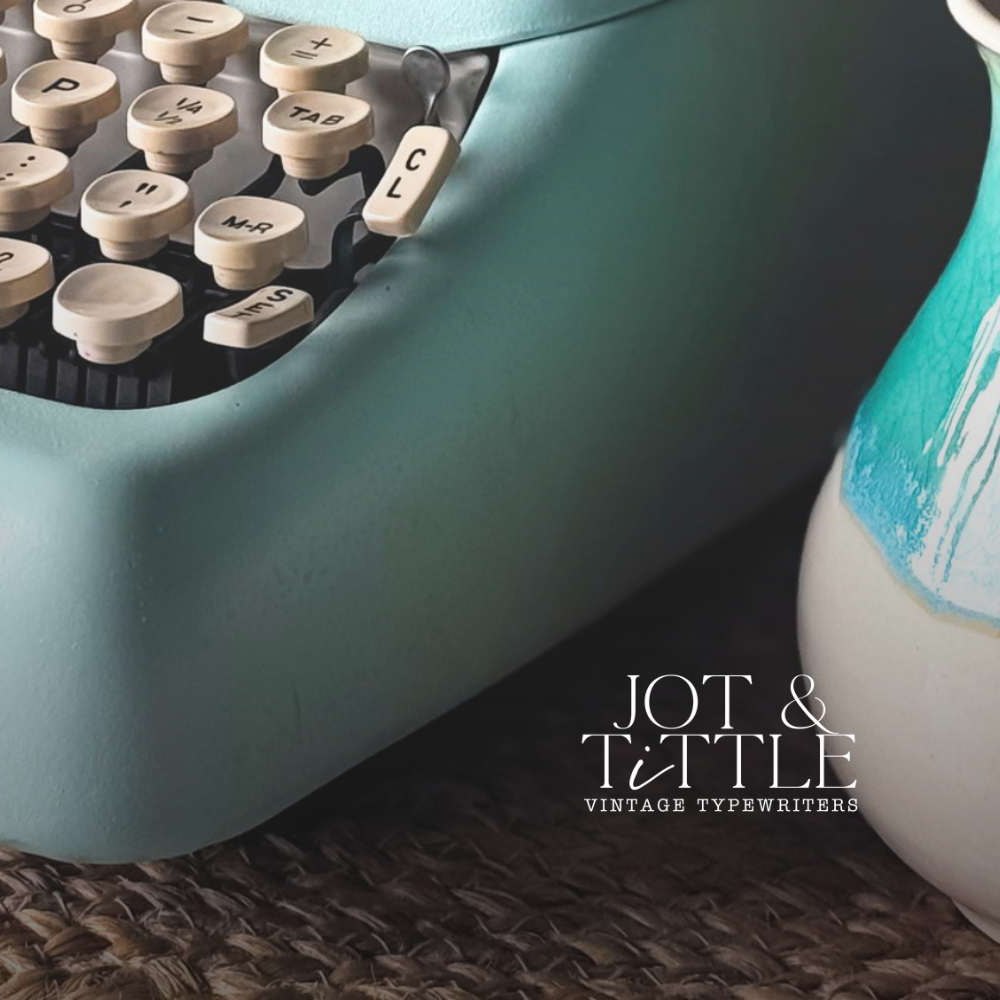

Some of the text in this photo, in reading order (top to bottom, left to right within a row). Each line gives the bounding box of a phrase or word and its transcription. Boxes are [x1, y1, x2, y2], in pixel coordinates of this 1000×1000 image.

[41, 77, 80, 94] P
[288, 106, 345, 126] TAB
[221, 215, 274, 235] M-R
[216, 288, 295, 319] SET
